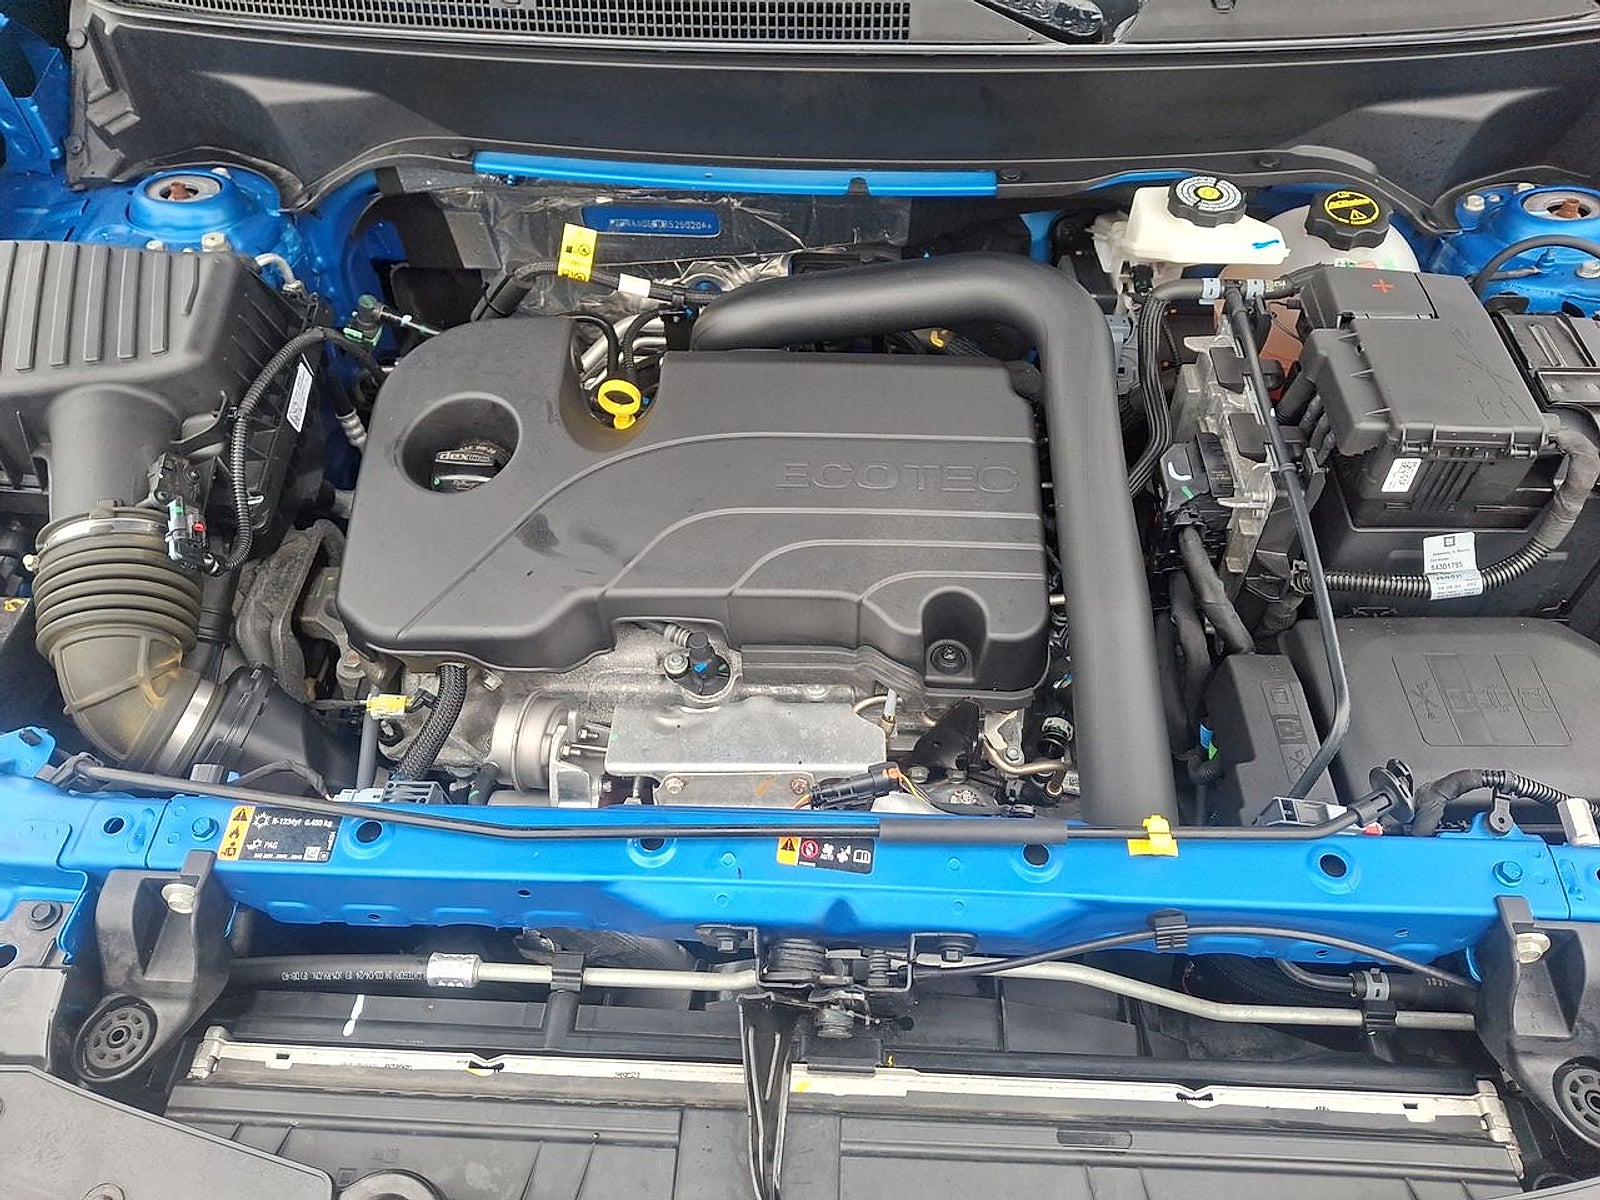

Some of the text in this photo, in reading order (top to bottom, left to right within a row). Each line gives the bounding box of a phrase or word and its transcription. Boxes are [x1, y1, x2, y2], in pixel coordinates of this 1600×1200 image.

[776, 462, 1020, 494] ECOTEC
[271, 817, 303, 828] R-1234yf
[323, 818, 333, 828] kg
[263, 841, 279, 849] PAG
